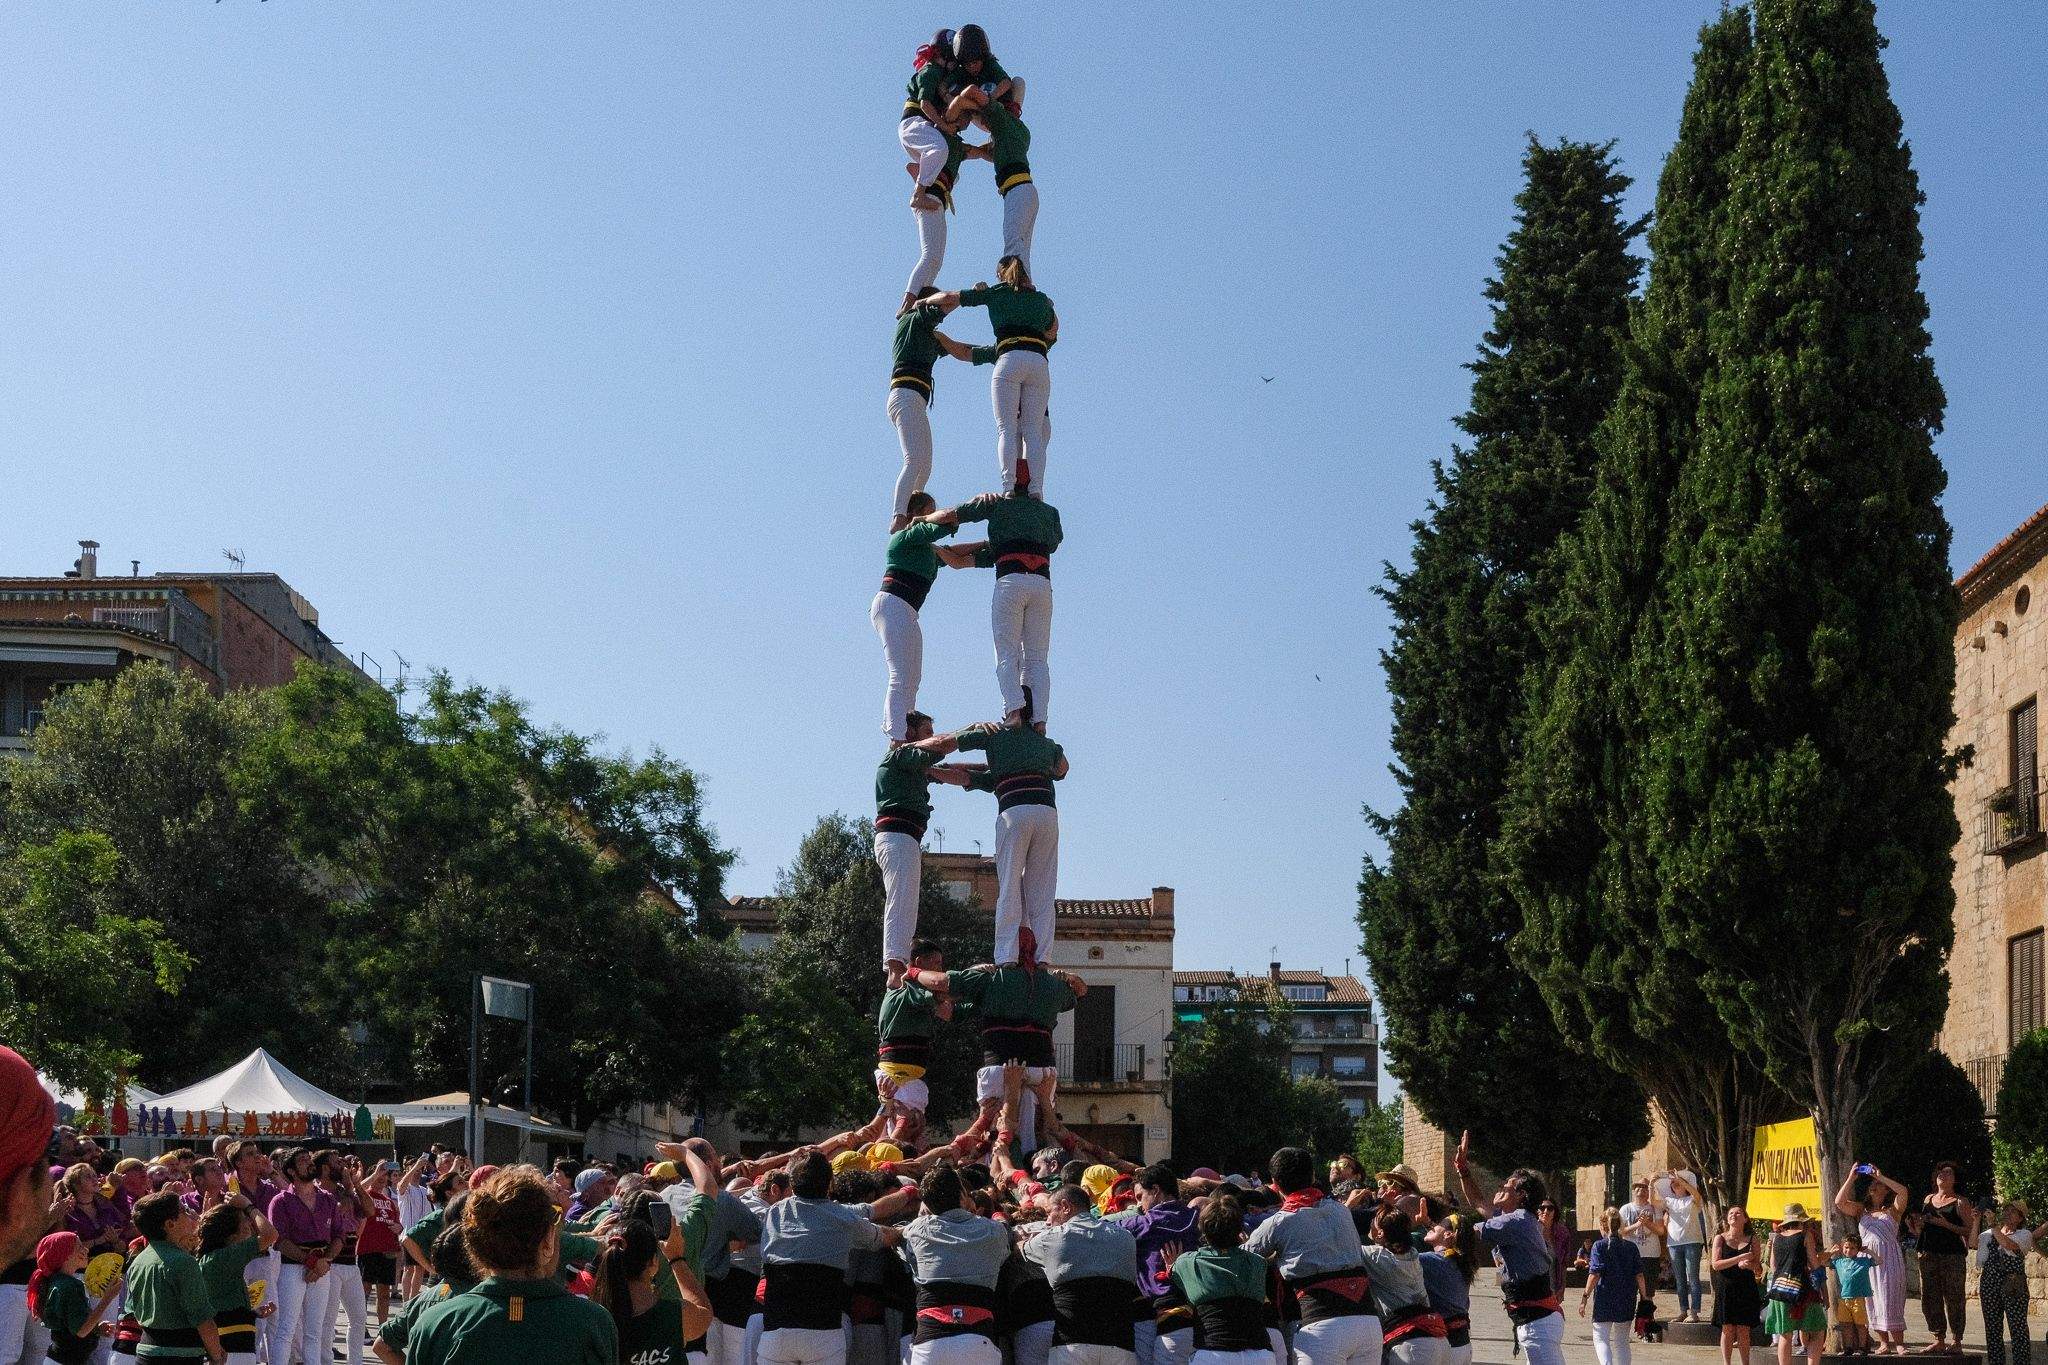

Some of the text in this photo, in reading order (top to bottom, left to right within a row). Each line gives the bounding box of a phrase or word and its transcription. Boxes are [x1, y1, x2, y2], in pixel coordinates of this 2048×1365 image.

[1755, 1150, 1766, 1185] OS
[1784, 1148, 1791, 1184] A
[1791, 1145, 1818, 1185] CASA!
